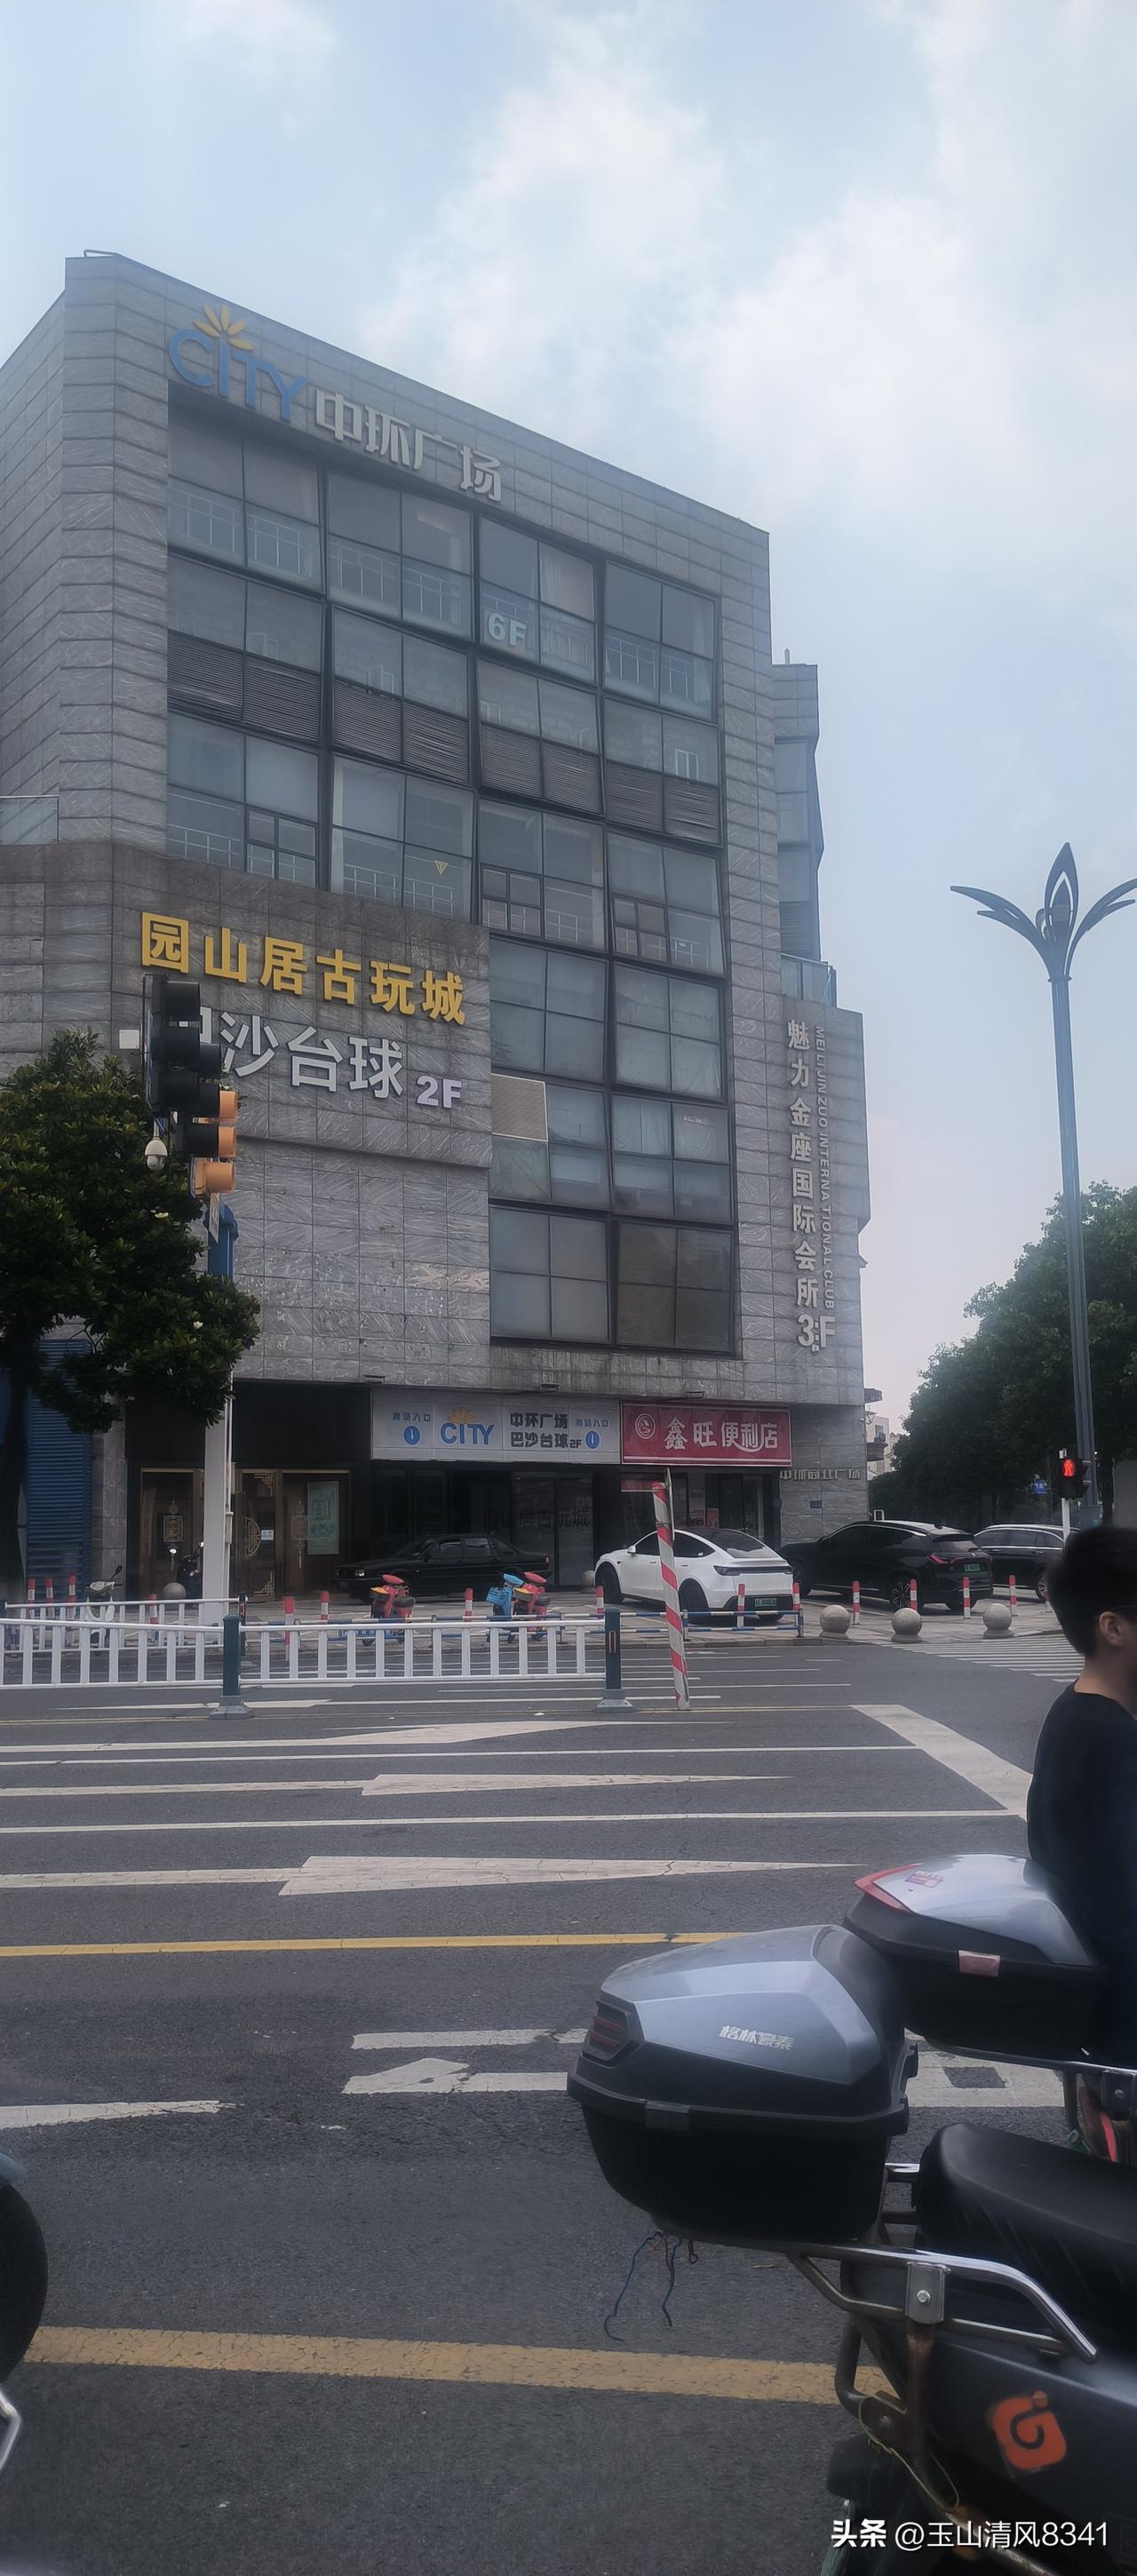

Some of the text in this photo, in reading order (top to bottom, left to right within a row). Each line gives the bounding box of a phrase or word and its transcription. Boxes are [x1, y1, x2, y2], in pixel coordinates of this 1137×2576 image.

[168, 327, 503, 503] CITY 中环广场
[489, 613, 527, 647] 6F
[141, 911, 466, 1025] 园山居古玩城
[179, 1006, 463, 1109] 沙台球 2F
[788, 1020, 819, 1308] 魅力金座国际会所
[823, 1269, 835, 1309] CLUB
[441, 1422, 495, 1445] CITY
[510, 1412, 568, 1430] 中环广场
[664, 1416, 778, 1453] 鑫旺便利店
[510, 1431, 568, 1449] 巴沙台球
[719, 2024, 795, 2051] 格林豪泰
